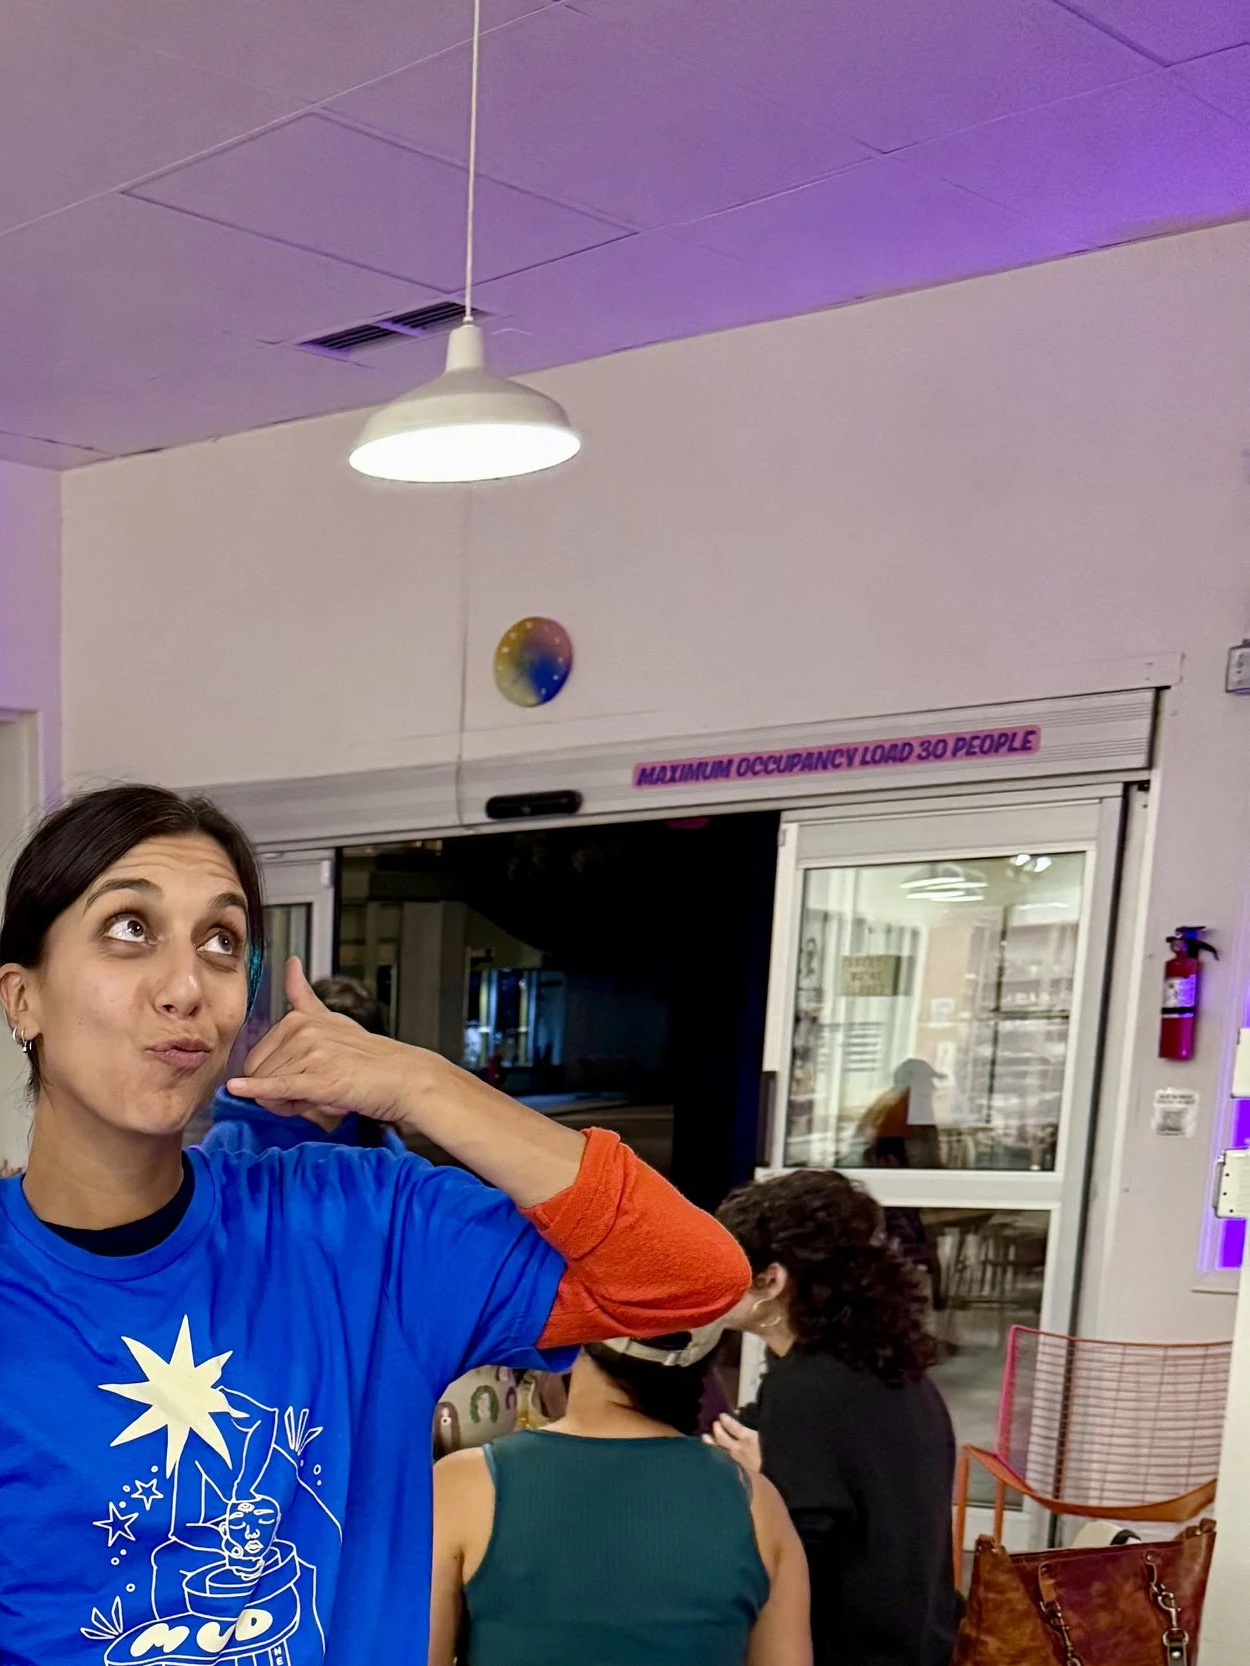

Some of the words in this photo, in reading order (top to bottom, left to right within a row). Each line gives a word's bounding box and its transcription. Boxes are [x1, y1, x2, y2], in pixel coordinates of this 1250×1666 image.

[636, 758, 733, 786] MAXIMUM
[736, 748, 858, 777] OCCUPANCY
[860, 741, 912, 766] LOAD
[916, 738, 947, 760] 30
[951, 730, 1037, 758] PEOPLE
[130, 1609, 273, 1657] MUD
